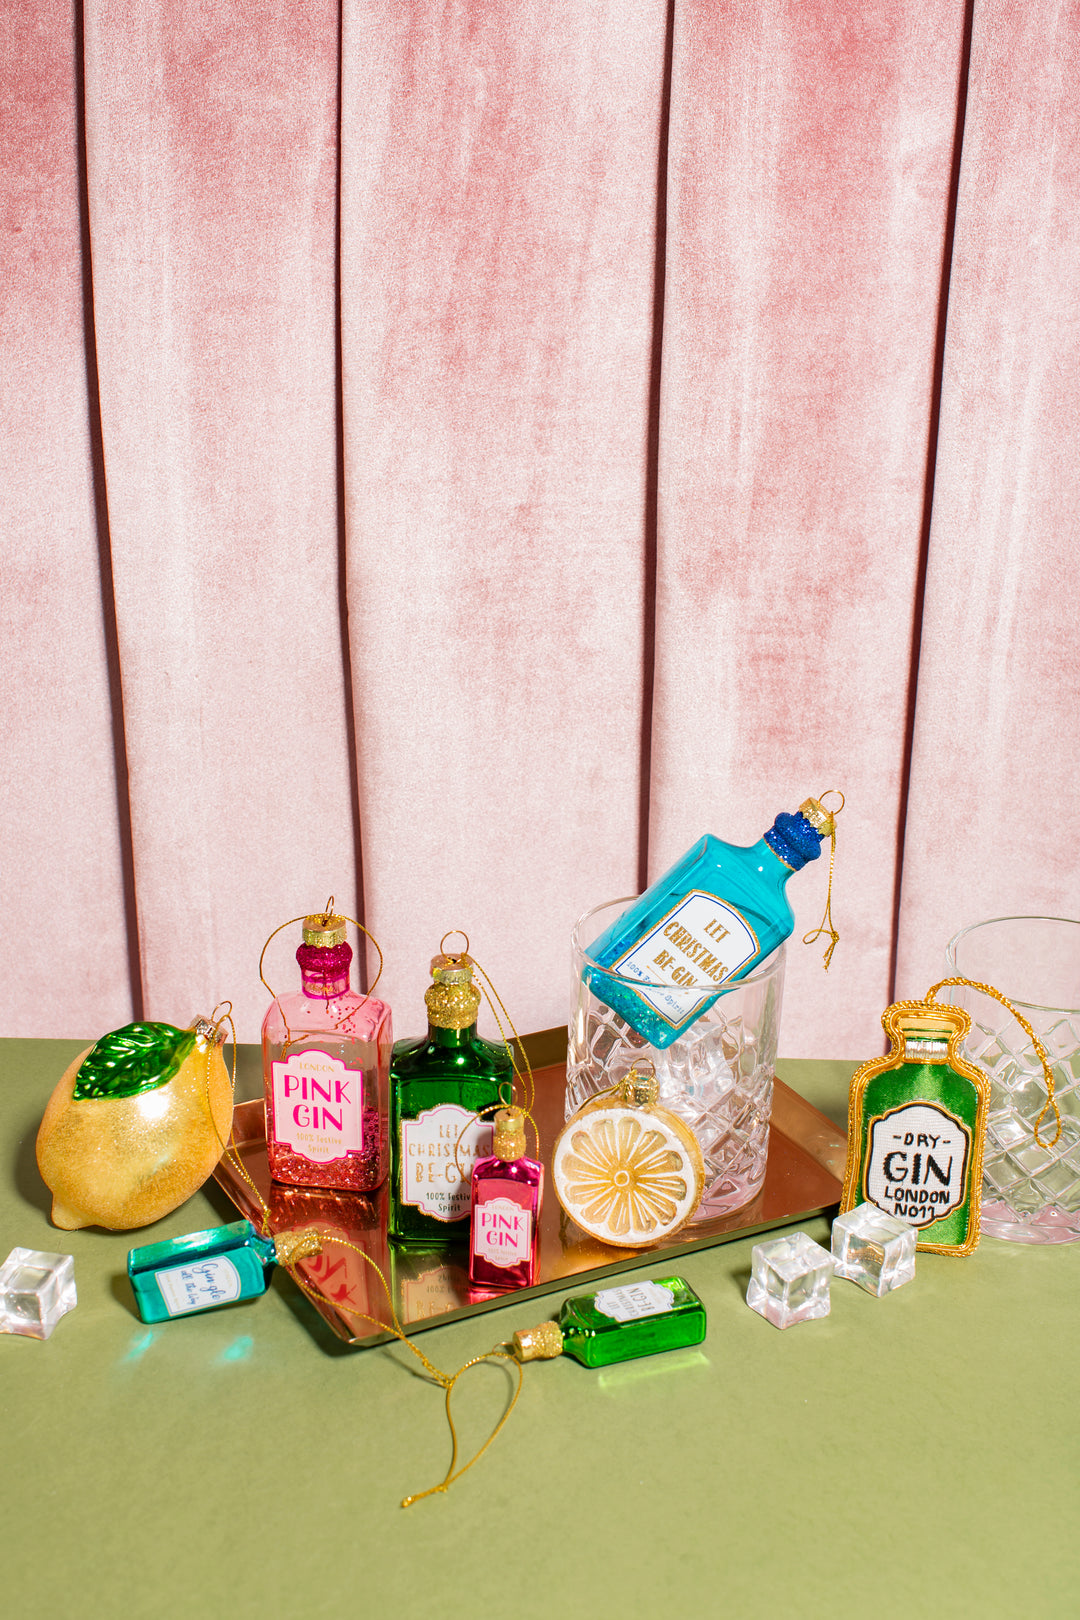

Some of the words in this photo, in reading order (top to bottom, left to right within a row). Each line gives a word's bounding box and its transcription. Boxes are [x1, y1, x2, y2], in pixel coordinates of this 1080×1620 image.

[704, 918, 731, 943] LET
[663, 921, 728, 981] CHRISTMAS
[299, 1062, 335, 1072] LONDON
[284, 1074, 351, 1104] PINK
[292, 1104, 343, 1131] GIN
[297, 1132, 314, 1142] 100%
[439, 1124, 459, 1138] LET
[308, 1144, 330, 1154] Spirit
[882, 1150, 953, 1186] GIN
[426, 1192, 446, 1201] 100%
[447, 1191, 472, 1201] Festiv
[884, 1186, 950, 1204] LONDON
[438, 1202, 461, 1213] Spirit
[481, 1212, 524, 1231] PINK
[486, 1230, 518, 1248] GIN
